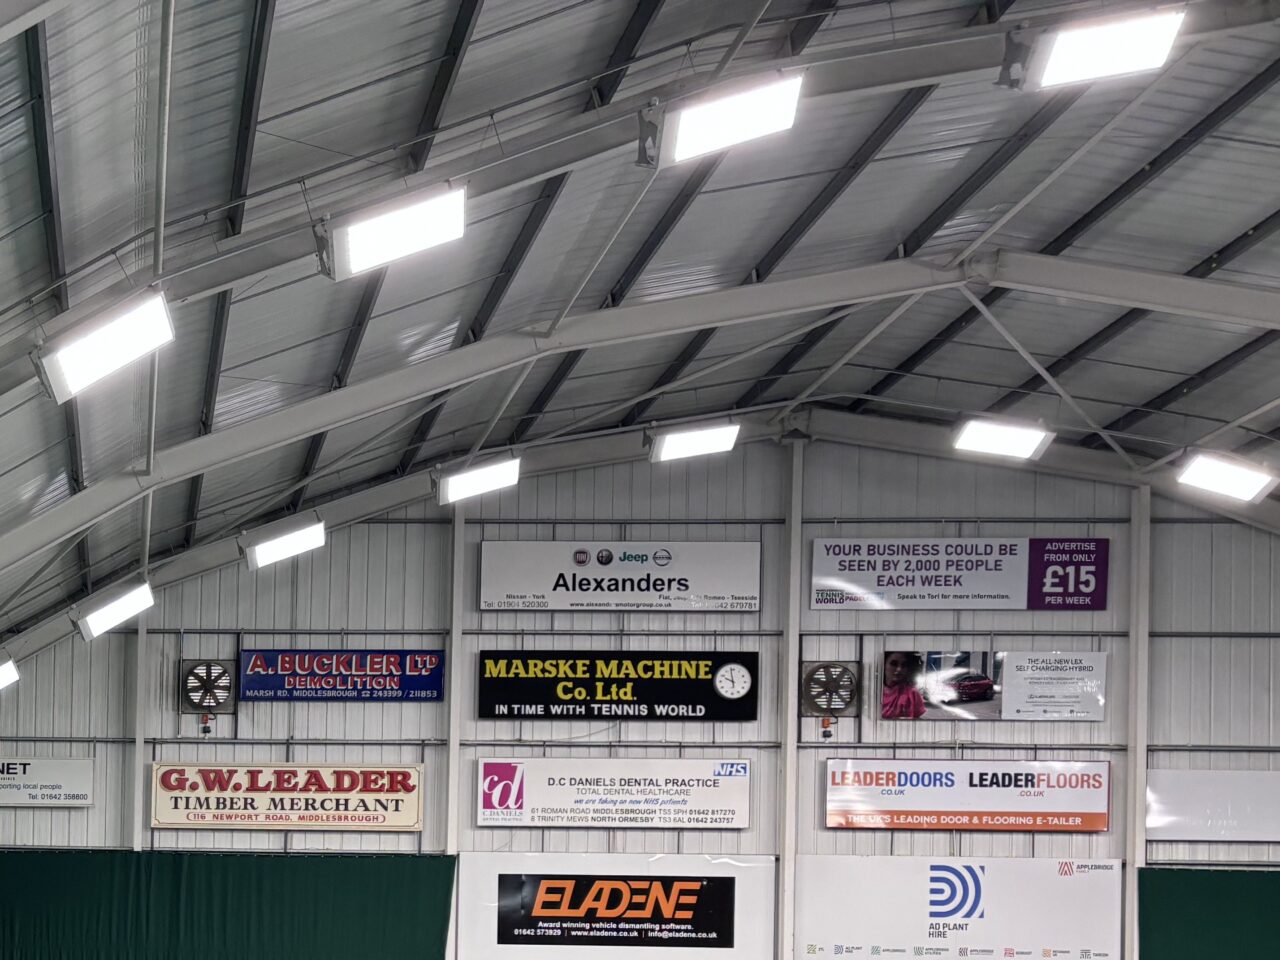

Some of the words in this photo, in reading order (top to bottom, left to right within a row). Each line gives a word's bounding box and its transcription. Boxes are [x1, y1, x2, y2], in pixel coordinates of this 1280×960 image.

[824, 544, 862, 556] YOUR
[867, 544, 940, 556] BUSINESS
[945, 543, 994, 556] COULD
[1000, 543, 1018, 556] BE
[1045, 542, 1096, 551] ADVERTISE
[619, 551, 648, 564] Jeep
[1044, 553, 1070, 562] FROM
[1072, 553, 1096, 562] ONLY
[838, 559, 877, 571] SEEN
[882, 559, 899, 571] BY
[904, 559, 940, 573] 2,000
[946, 559, 1003, 572] PEOPLE
[552, 573, 689, 592] Alexanders
[877, 575, 916, 587] EACH
[920, 575, 963, 587] WEEK
[1043, 565, 1096, 593] £15
[816, 597, 844, 605] WORLD
[1045, 596, 1062, 605] PER
[1065, 596, 1091, 605] WEEK
[484, 659, 590, 678] MARSKE
[595, 660, 712, 680] MACHINE
[285, 675, 400, 689] DEMOLITION
[246, 689, 274, 697] MARSH
[277, 689, 290, 697] RD.
[293, 689, 358, 697] MIDDLESBROUGH
[372, 690, 402, 698] 243399
[409, 690, 437, 698] 211853
[556, 681, 591, 700] Co.
[595, 681, 637, 701] Ltd.
[495, 704, 508, 715] IN
[512, 704, 545, 715] TIME
[550, 705, 585, 715] WITH
[591, 704, 648, 716] TENNIS
[654, 705, 705, 716] WORLD
[716, 763, 746, 775] NHS
[547, 777, 566, 786] D.C
[569, 777, 616, 786] DANIELS
[619, 778, 662, 787] DENTAL
[665, 778, 720, 787] PRACTICE
[831, 771, 955, 788] LEADERDOORS
[969, 772, 1102, 789] LEADERFLOORS
[41, 793, 62, 801] 01642
[576, 787, 601, 795] TOTAL
[636, 788, 692, 796] HEALTHCARE
[170, 796, 259, 811] TIMBER
[266, 797, 405, 812] MERCHANT
[213, 813, 260, 821] NEWPORT
[298, 814, 379, 823] MIDDLESBROUGH
[847, 814, 866, 823] THE
[869, 814, 891, 823] UK'S
[894, 814, 938, 824] LEADING
[941, 815, 969, 824] DOOR
[972, 816, 979, 824] &
[982, 815, 1033, 825] FLOORING
[1036, 816, 1082, 825] E-TAILER
[531, 879, 702, 919] ELADENE
[562, 921, 590, 929] winning
[618, 922, 660, 930] dismantling
[942, 923, 968, 931] PLANT
[928, 930, 948, 938] HIRE
